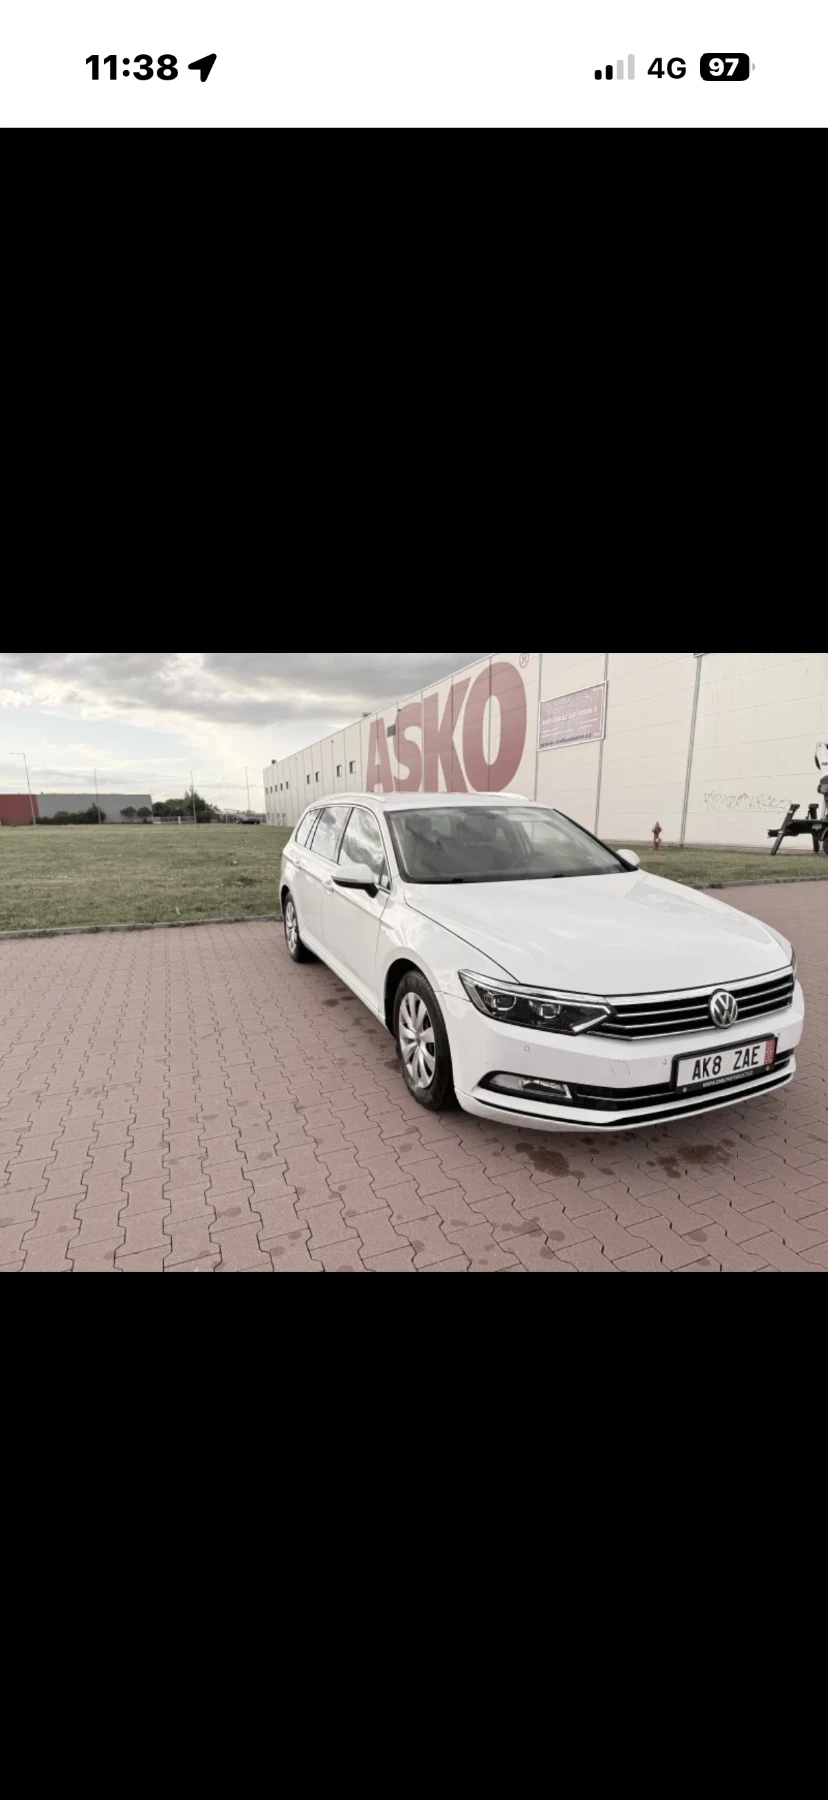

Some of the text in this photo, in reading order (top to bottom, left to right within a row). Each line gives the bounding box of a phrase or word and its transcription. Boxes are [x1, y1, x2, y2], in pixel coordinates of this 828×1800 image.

[365, 661, 528, 793] ASKO
[691, 1055, 722, 1081] AK8
[732, 1045, 761, 1071] ZAE
